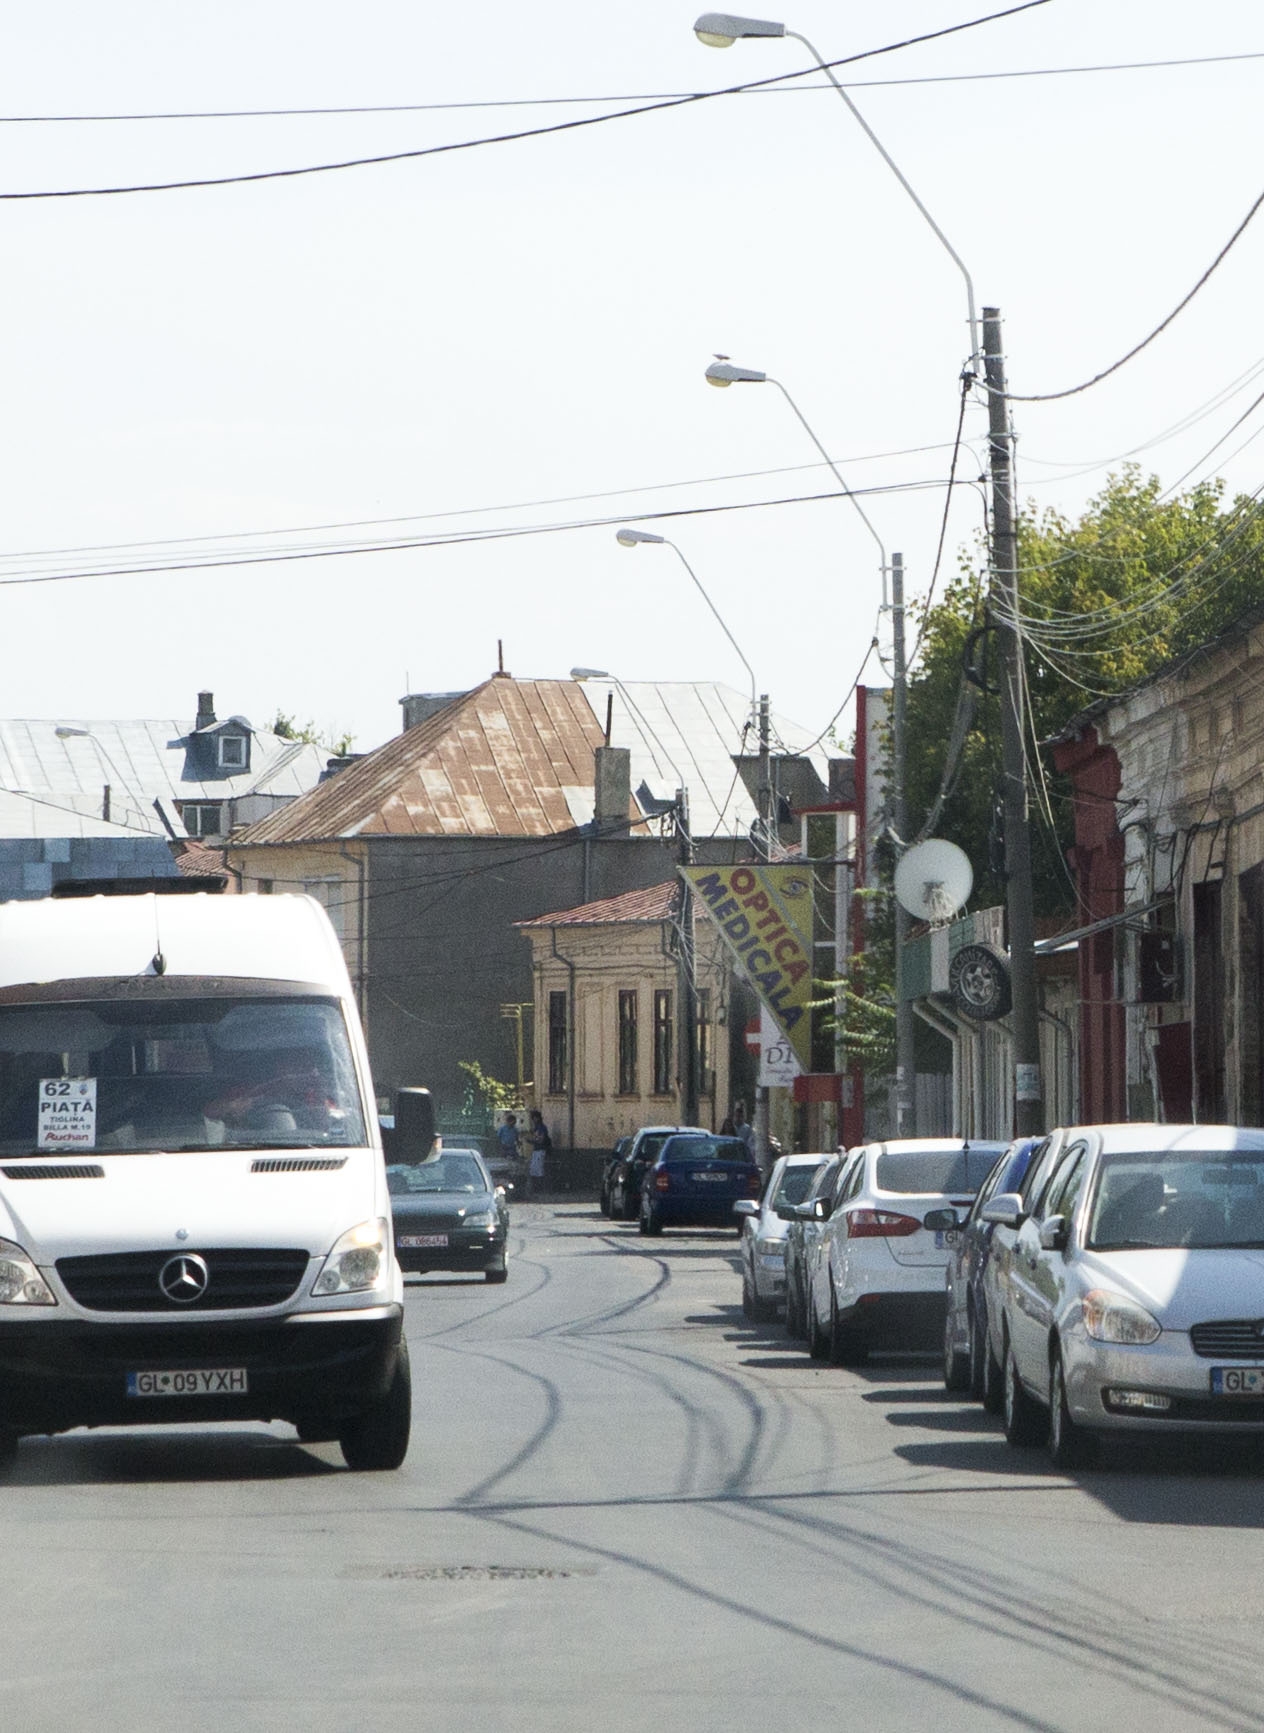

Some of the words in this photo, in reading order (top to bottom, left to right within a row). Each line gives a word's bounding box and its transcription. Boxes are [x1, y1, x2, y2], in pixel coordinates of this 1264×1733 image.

[695, 872, 805, 1030] MEDICALA
[729, 867, 811, 986] OPTICA
[44, 1082, 71, 1096] 62
[45, 1132, 89, 1141] Auchan
